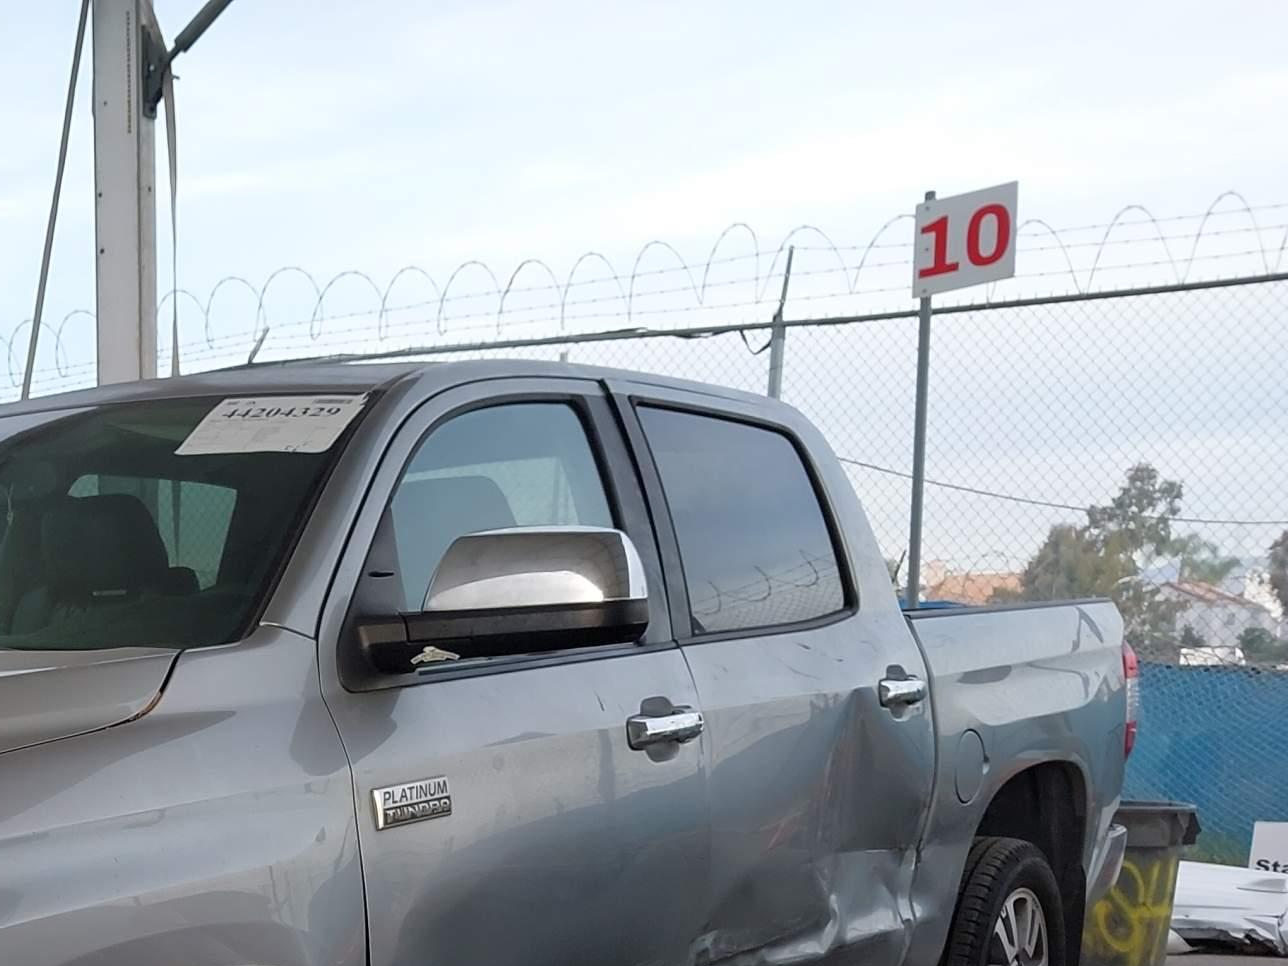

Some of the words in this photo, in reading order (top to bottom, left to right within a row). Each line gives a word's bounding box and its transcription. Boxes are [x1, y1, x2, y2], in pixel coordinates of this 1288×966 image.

[918, 203, 1011, 279] 10
[222, 406, 342, 419] 44204329
[383, 779, 449, 806] PLATINUM
